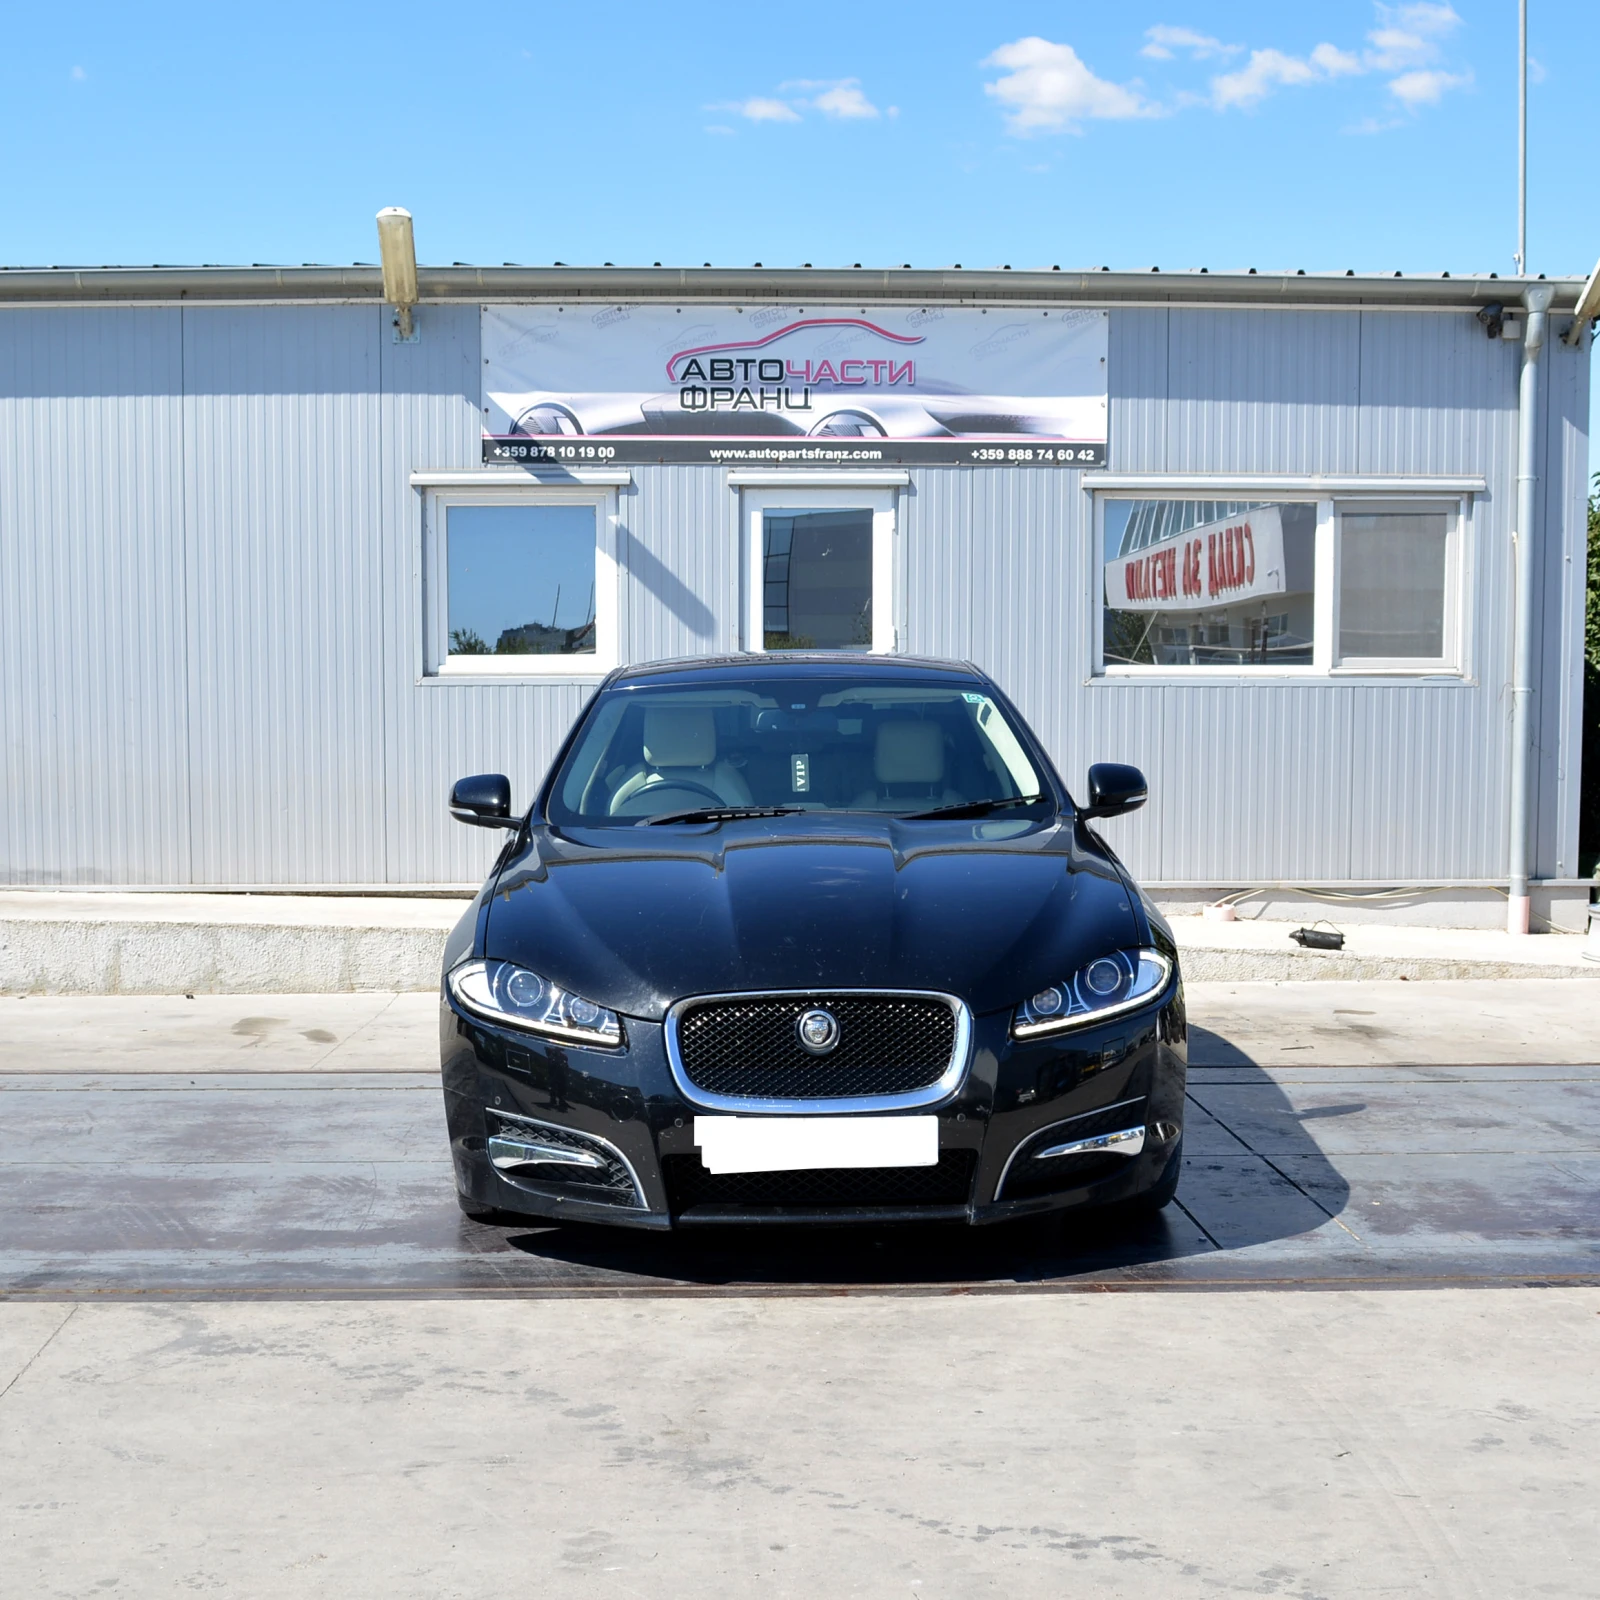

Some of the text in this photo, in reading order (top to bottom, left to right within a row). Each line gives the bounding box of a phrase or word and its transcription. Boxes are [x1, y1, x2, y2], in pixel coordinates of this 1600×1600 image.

[680, 358, 914, 384] АВТОЧАСТИ
[680, 385, 812, 411] ФРАНЦ
[494, 446, 615, 458] +359 878 10 19 00
[710, 448, 882, 460] www.autopartsfranz.com
[971, 449, 1095, 460] +359 888 74 60 42
[796, 760, 806, 787] VIP
